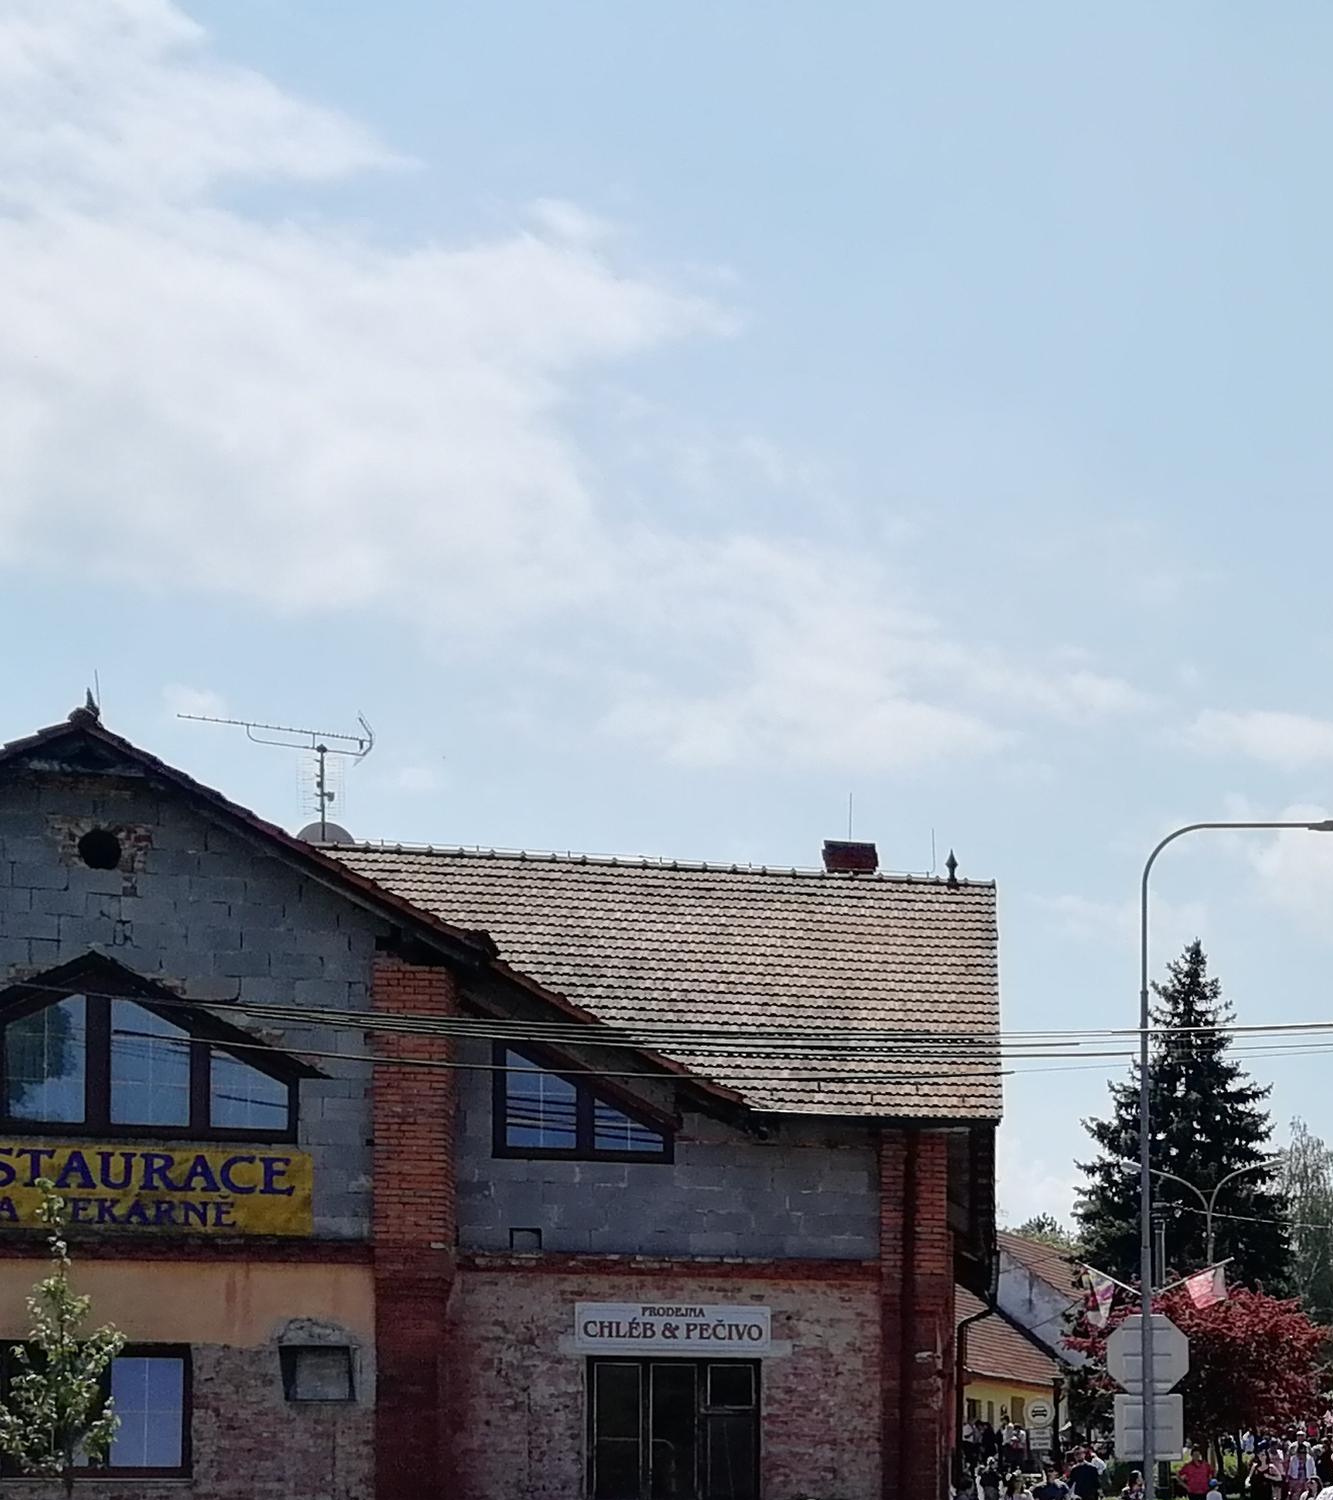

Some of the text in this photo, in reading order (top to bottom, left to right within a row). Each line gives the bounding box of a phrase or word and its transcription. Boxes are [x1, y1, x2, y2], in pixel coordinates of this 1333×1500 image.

[47, 1194, 236, 1228] EKÁRNĚ
[641, 1306, 706, 1318] PRODEJNA
[583, 1317, 764, 1342] CHLÉB & PEČIVO
